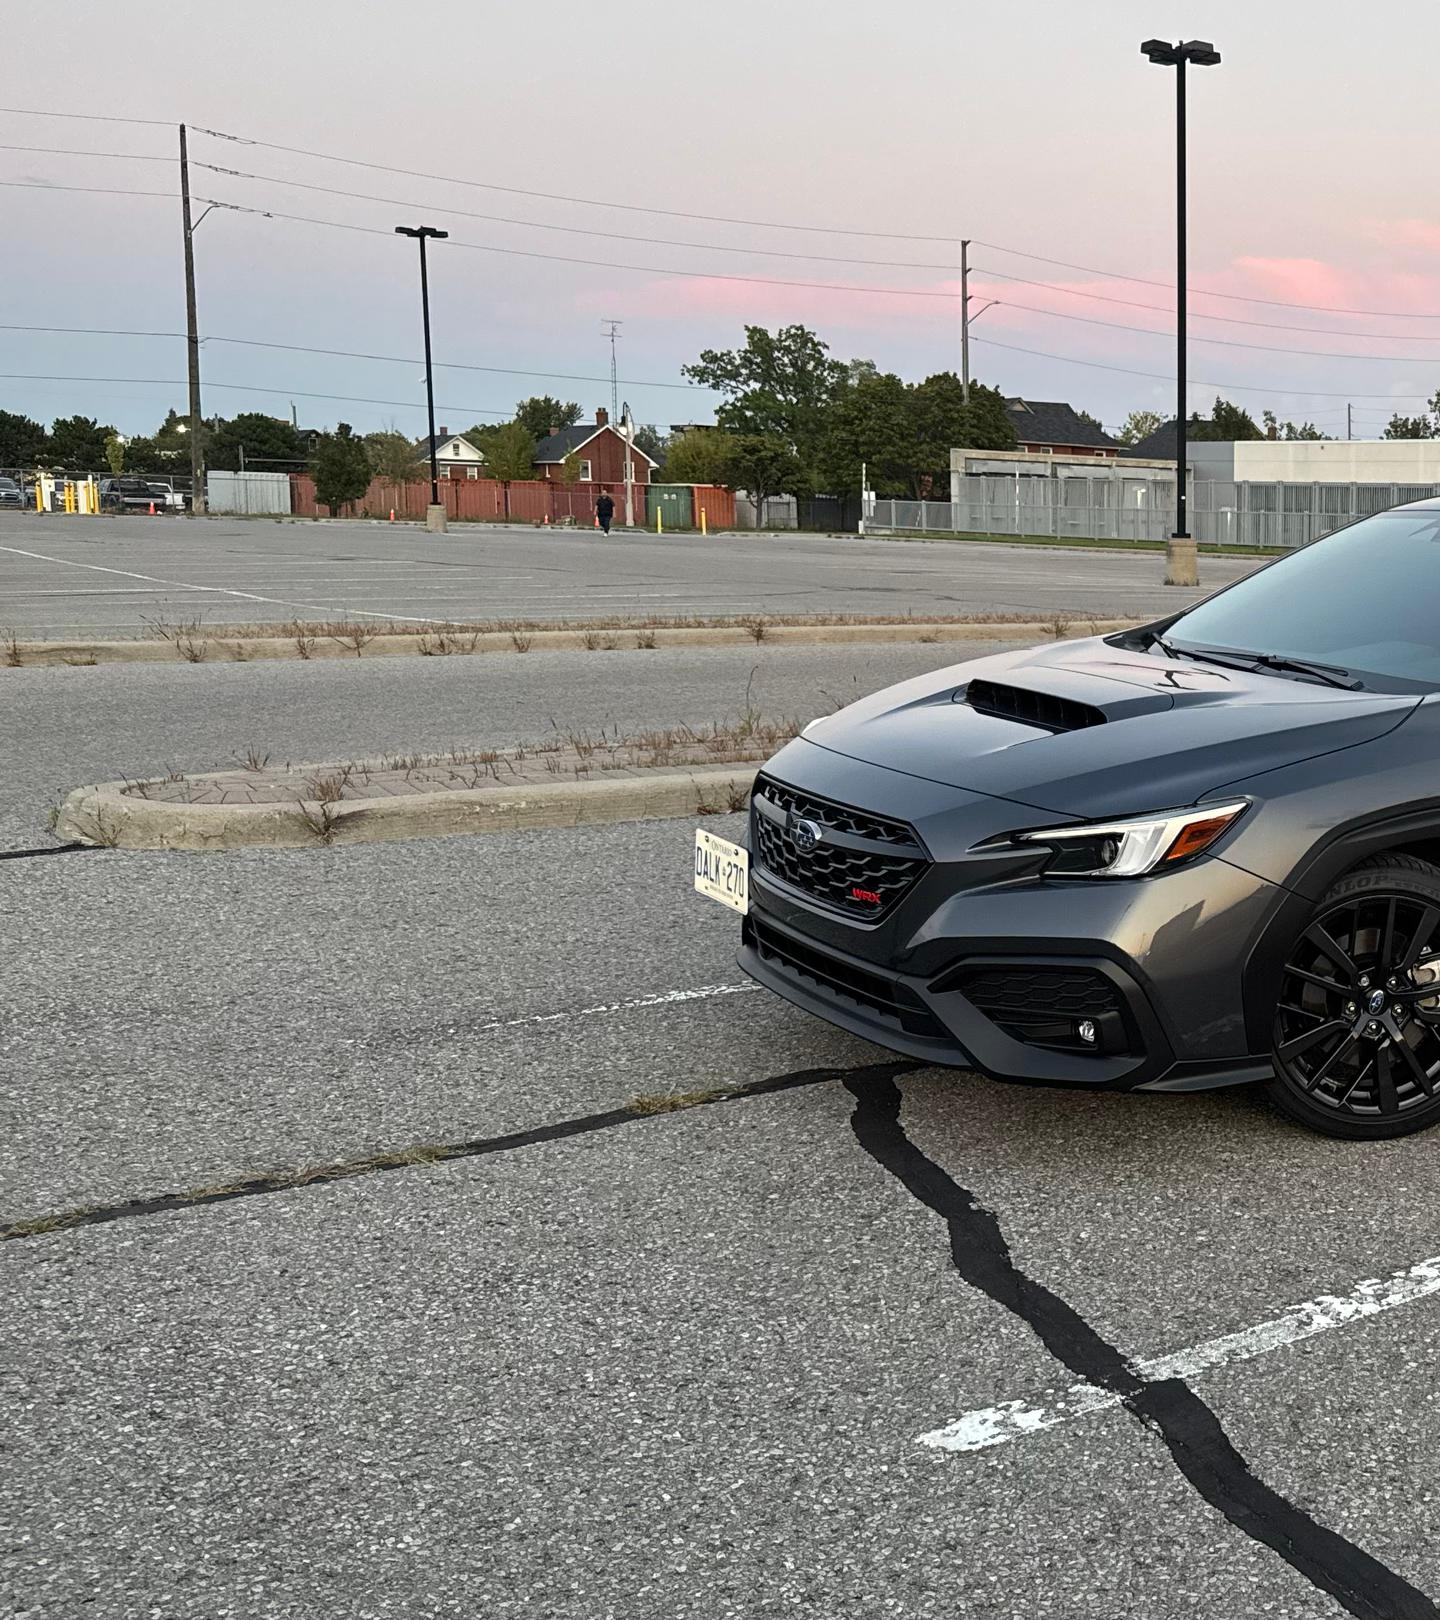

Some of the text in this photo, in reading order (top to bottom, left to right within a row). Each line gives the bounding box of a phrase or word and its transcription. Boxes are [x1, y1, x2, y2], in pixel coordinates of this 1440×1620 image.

[696, 846, 744, 898] DALK 270
[852, 887, 881, 904] WRX
